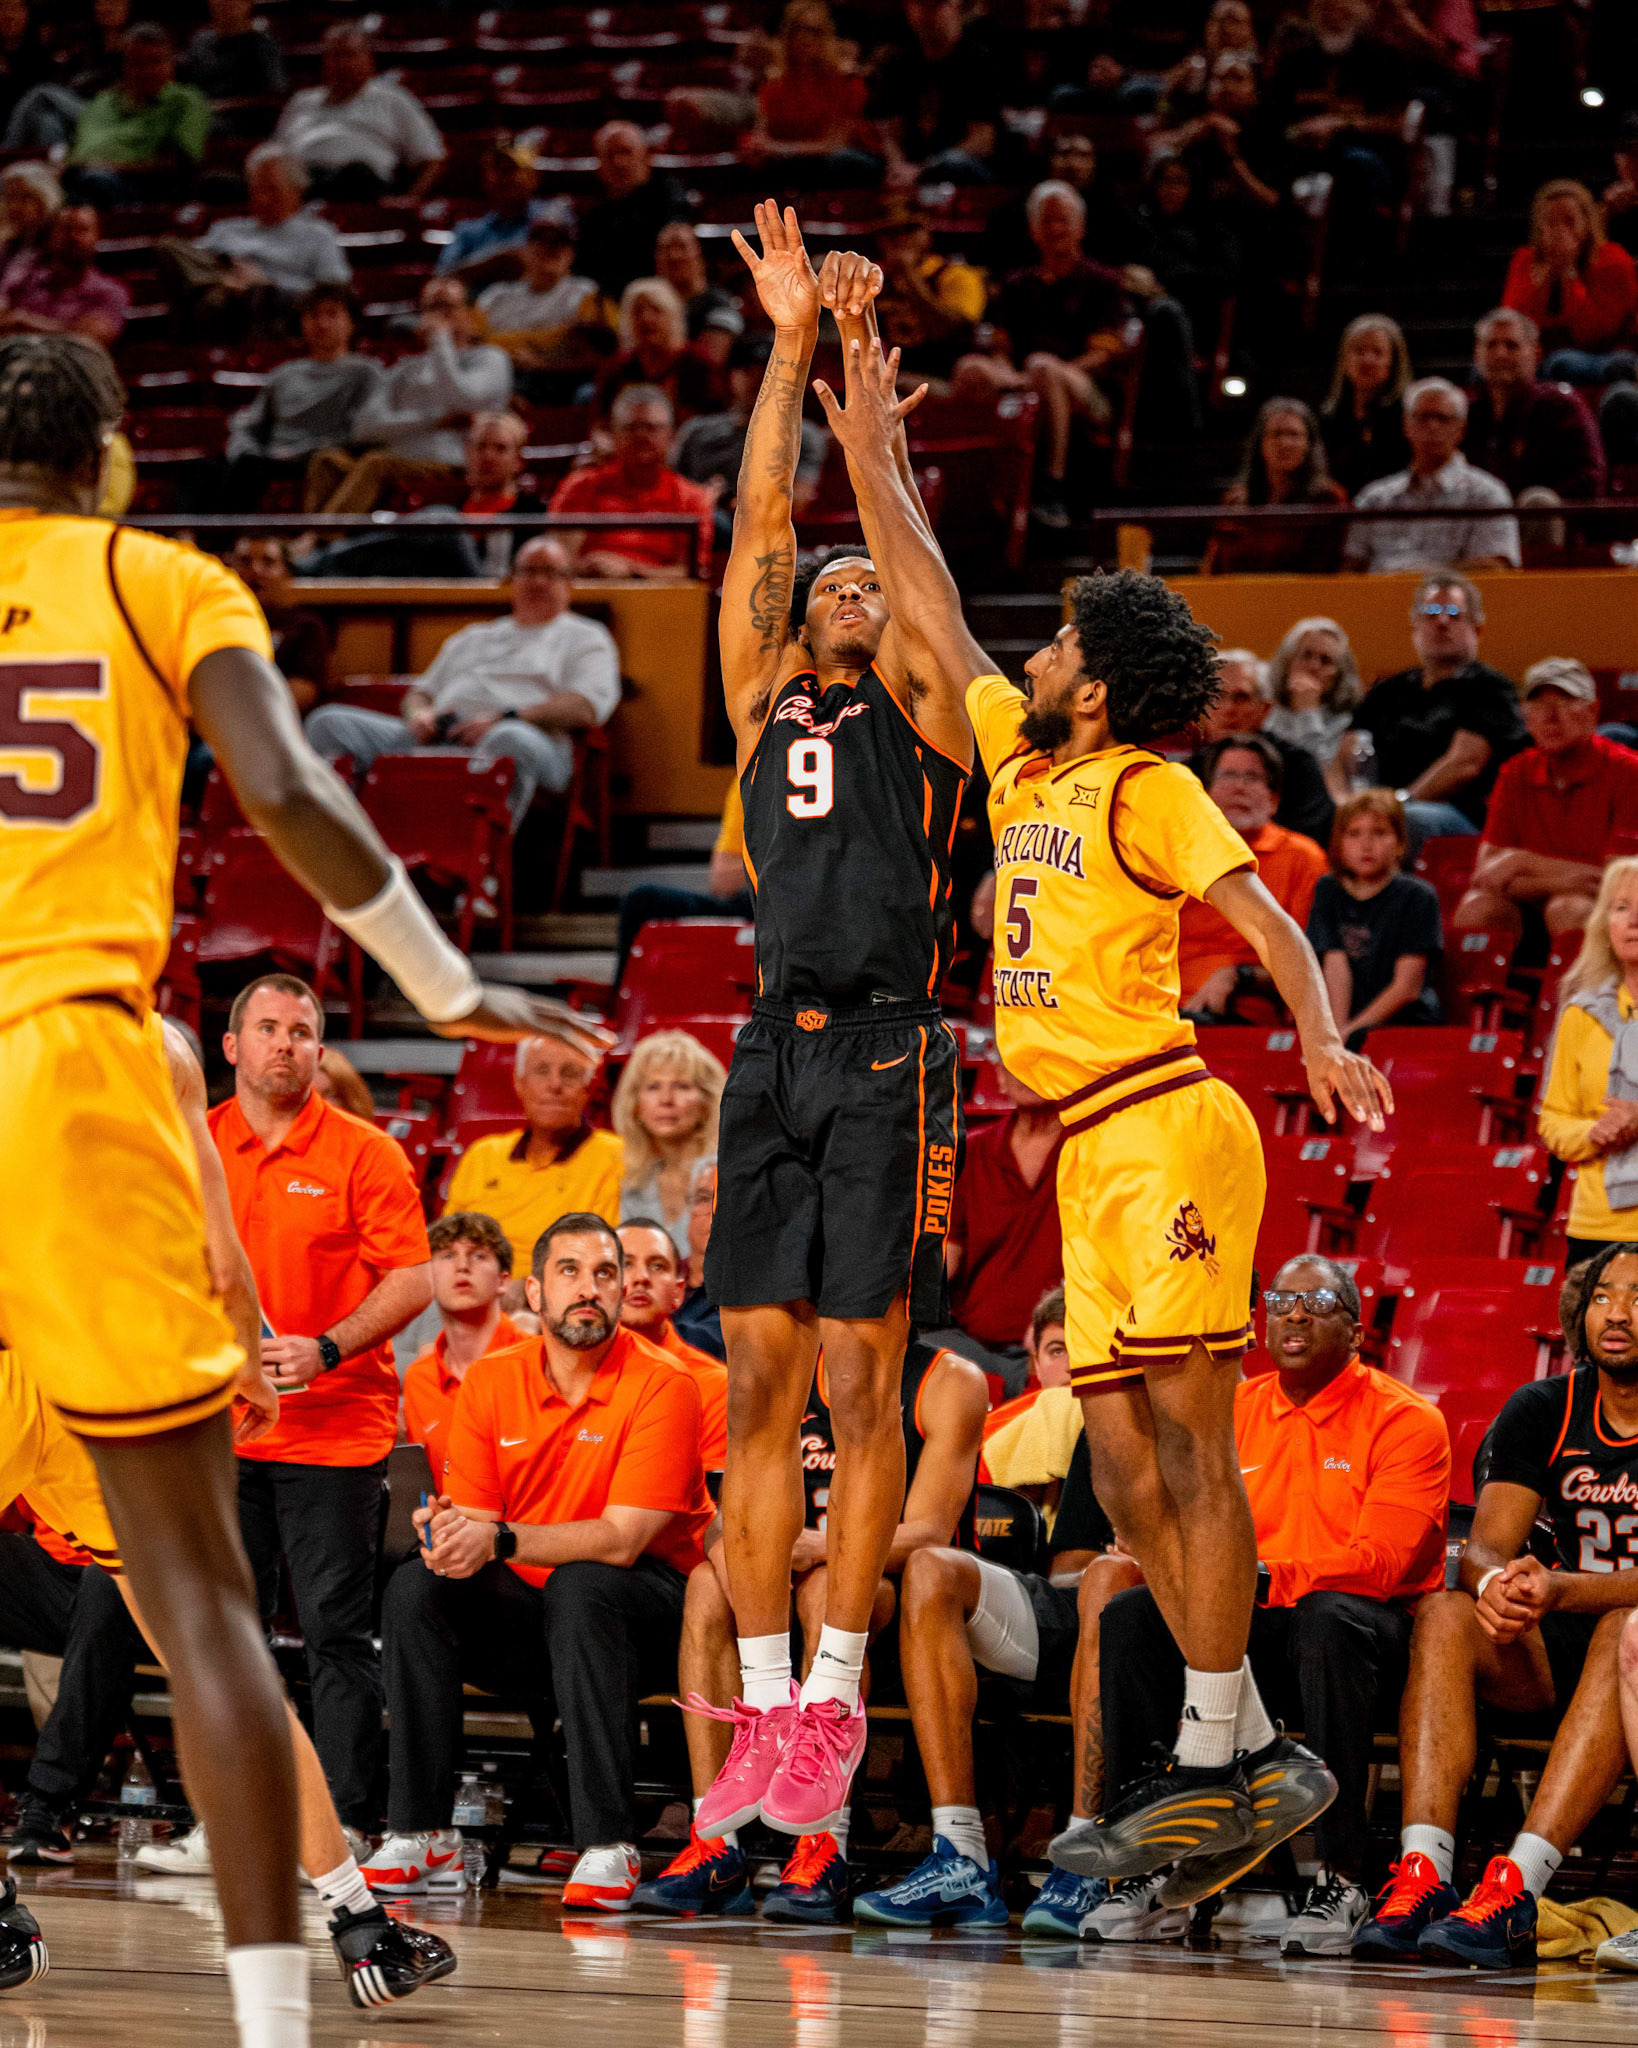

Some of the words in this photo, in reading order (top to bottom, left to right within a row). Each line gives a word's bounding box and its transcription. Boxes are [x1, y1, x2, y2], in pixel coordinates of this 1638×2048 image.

[786, 736, 834, 820] 9
[1006, 877, 1038, 960] 5
[795, 1010, 828, 1031] OSU
[924, 1144, 954, 1234] POKES
[1561, 1465, 1638, 1510] Cowbo
